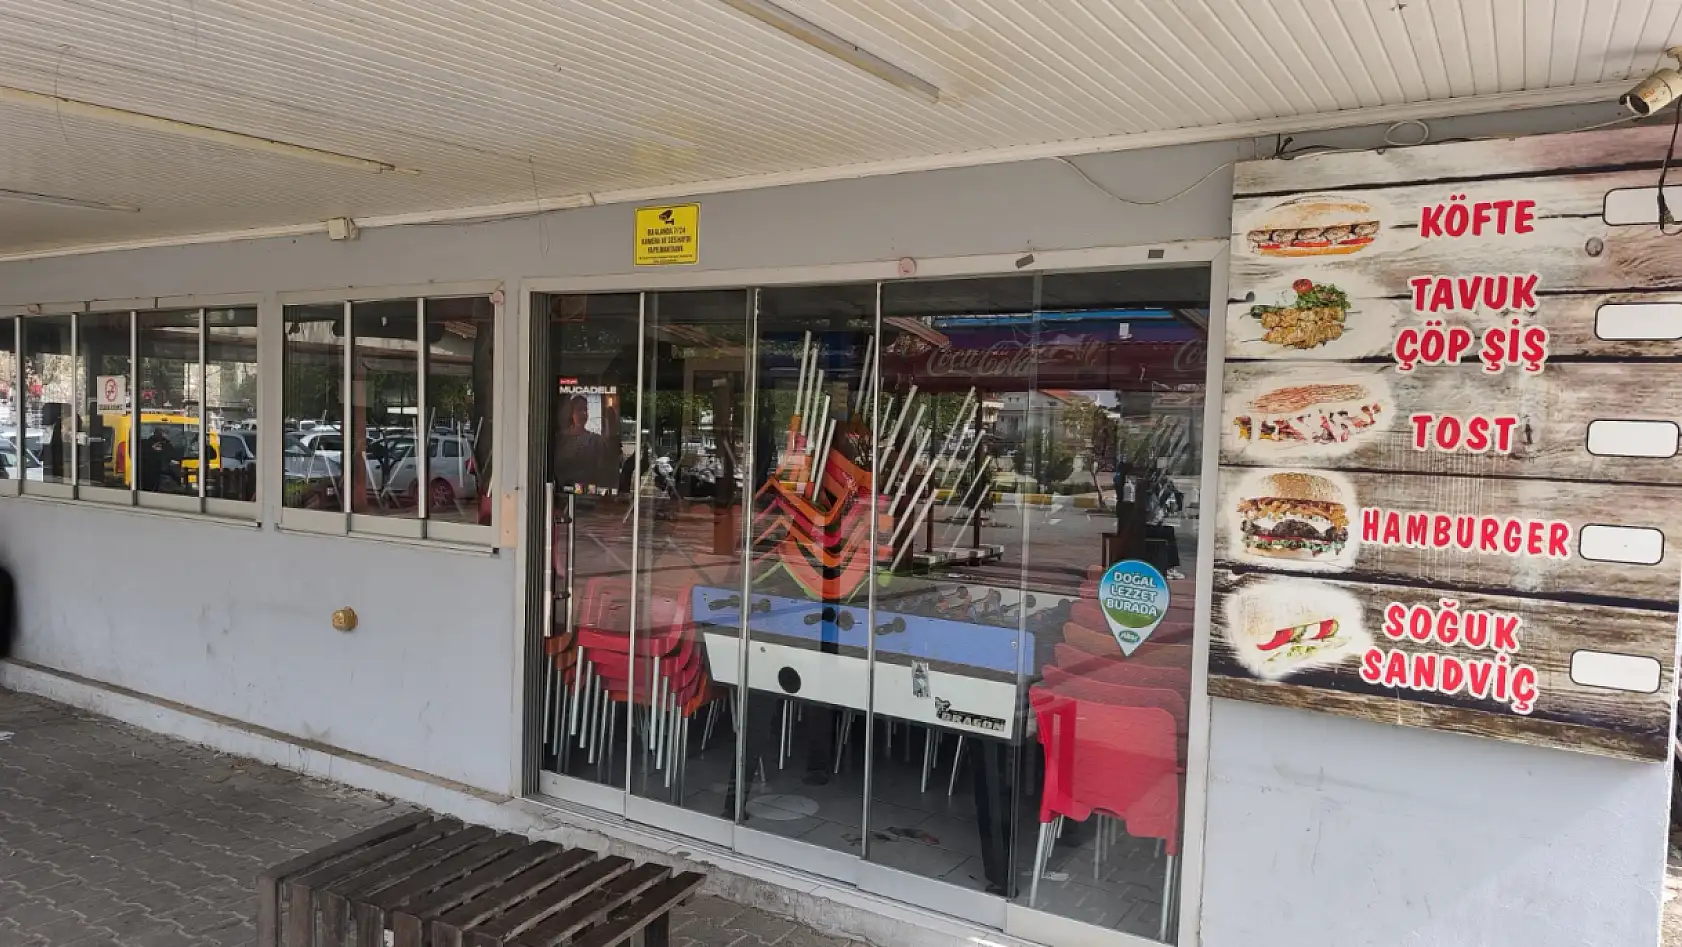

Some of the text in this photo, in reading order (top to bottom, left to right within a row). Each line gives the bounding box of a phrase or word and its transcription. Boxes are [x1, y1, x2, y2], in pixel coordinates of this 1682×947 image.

[1420, 194, 1537, 239] KÖFTE
[1411, 274, 1539, 313] TAVUK
[1395, 318, 1547, 371] ÇÖP ŞİŞ
[1412, 416, 1517, 453] TOST
[1362, 509, 1571, 557] HAMBURGER
[1111, 584, 1157, 602] LEZZET
[1114, 571, 1156, 587] DOĞAL
[1107, 598, 1157, 616] BURADA
[1386, 601, 1520, 651] SOĞUK
[1362, 650, 1536, 711] SANDVİÇ
[939, 709, 1006, 732] DRAGON
